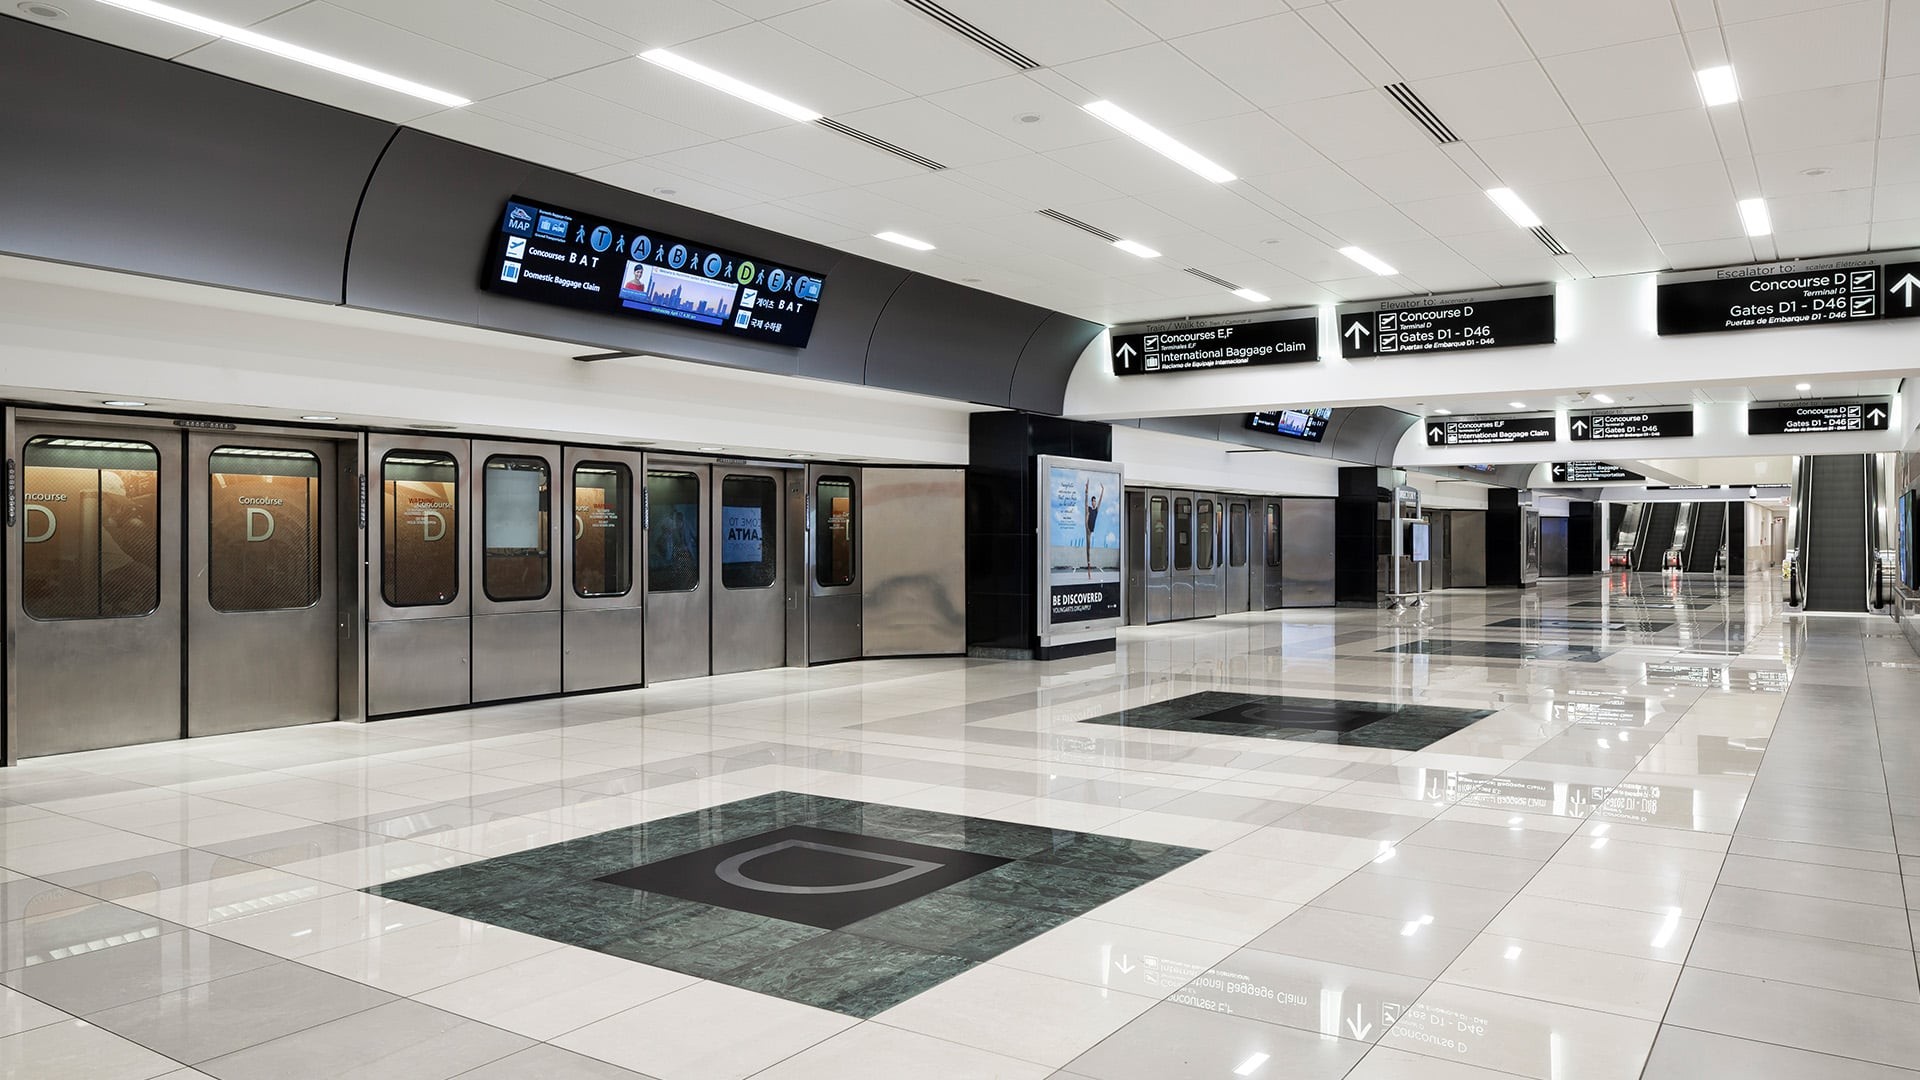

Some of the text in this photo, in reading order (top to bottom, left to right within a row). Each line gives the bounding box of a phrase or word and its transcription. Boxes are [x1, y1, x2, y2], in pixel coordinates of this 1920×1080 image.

[508, 219, 530, 231] MAP
[528, 247, 600, 268] Concourses B A T
[1717, 264, 1776, 279] Escalator
[1779, 264, 1796, 273] to:
[523, 269, 600, 292] Domestic Baggage Claim
[1750, 273, 1846, 292] Concourse D
[1803, 288, 1837, 297] Terminal
[778, 300, 785, 309] B
[786, 302, 793, 311] A
[796, 303, 803, 313] T
[1380, 299, 1420, 310] Elevator
[1423, 298, 1436, 306] to:
[1730, 304, 1774, 316] Gates
[1779, 301, 1796, 313] D1
[1813, 297, 1847, 311] D46
[1400, 306, 1473, 321] Concourse D
[1725, 318, 1755, 327] Puertas
[1756, 317, 1767, 325] de
[1768, 314, 1809, 324] Embarque
[1829, 311, 1847, 319] D46
[1146, 324, 1166, 333] Train
[1174, 321, 1194, 330] Walk
[1400, 322, 1425, 330] Terminal
[1160, 328, 1233, 343] Concourses E,F
[1400, 332, 1434, 342] Gates
[1438, 329, 1451, 339] D1
[1464, 325, 1490, 337] D46
[1161, 342, 1306, 361] International Baggage Claim
[1400, 343, 1423, 351] Puertas
[1424, 341, 1433, 349] de
[1433, 340, 1466, 348] Embarque
[1192, 359, 1214, 368] Equipaje
[1215, 357, 1249, 365] Internacional
[1796, 407, 1838, 415] Concourse
[1458, 421, 1493, 429] Concourses
[1604, 415, 1641, 423] Concourse
[1459, 431, 1498, 439] International
[1499, 430, 1529, 438] Baggage
[239, 496, 283, 505] Concourse
[24, 504, 56, 542] D
[247, 507, 275, 541] D
[424, 510, 446, 541] D
[1053, 592, 1103, 606] BE DISCOVERED
[715, 839, 946, 894] D
